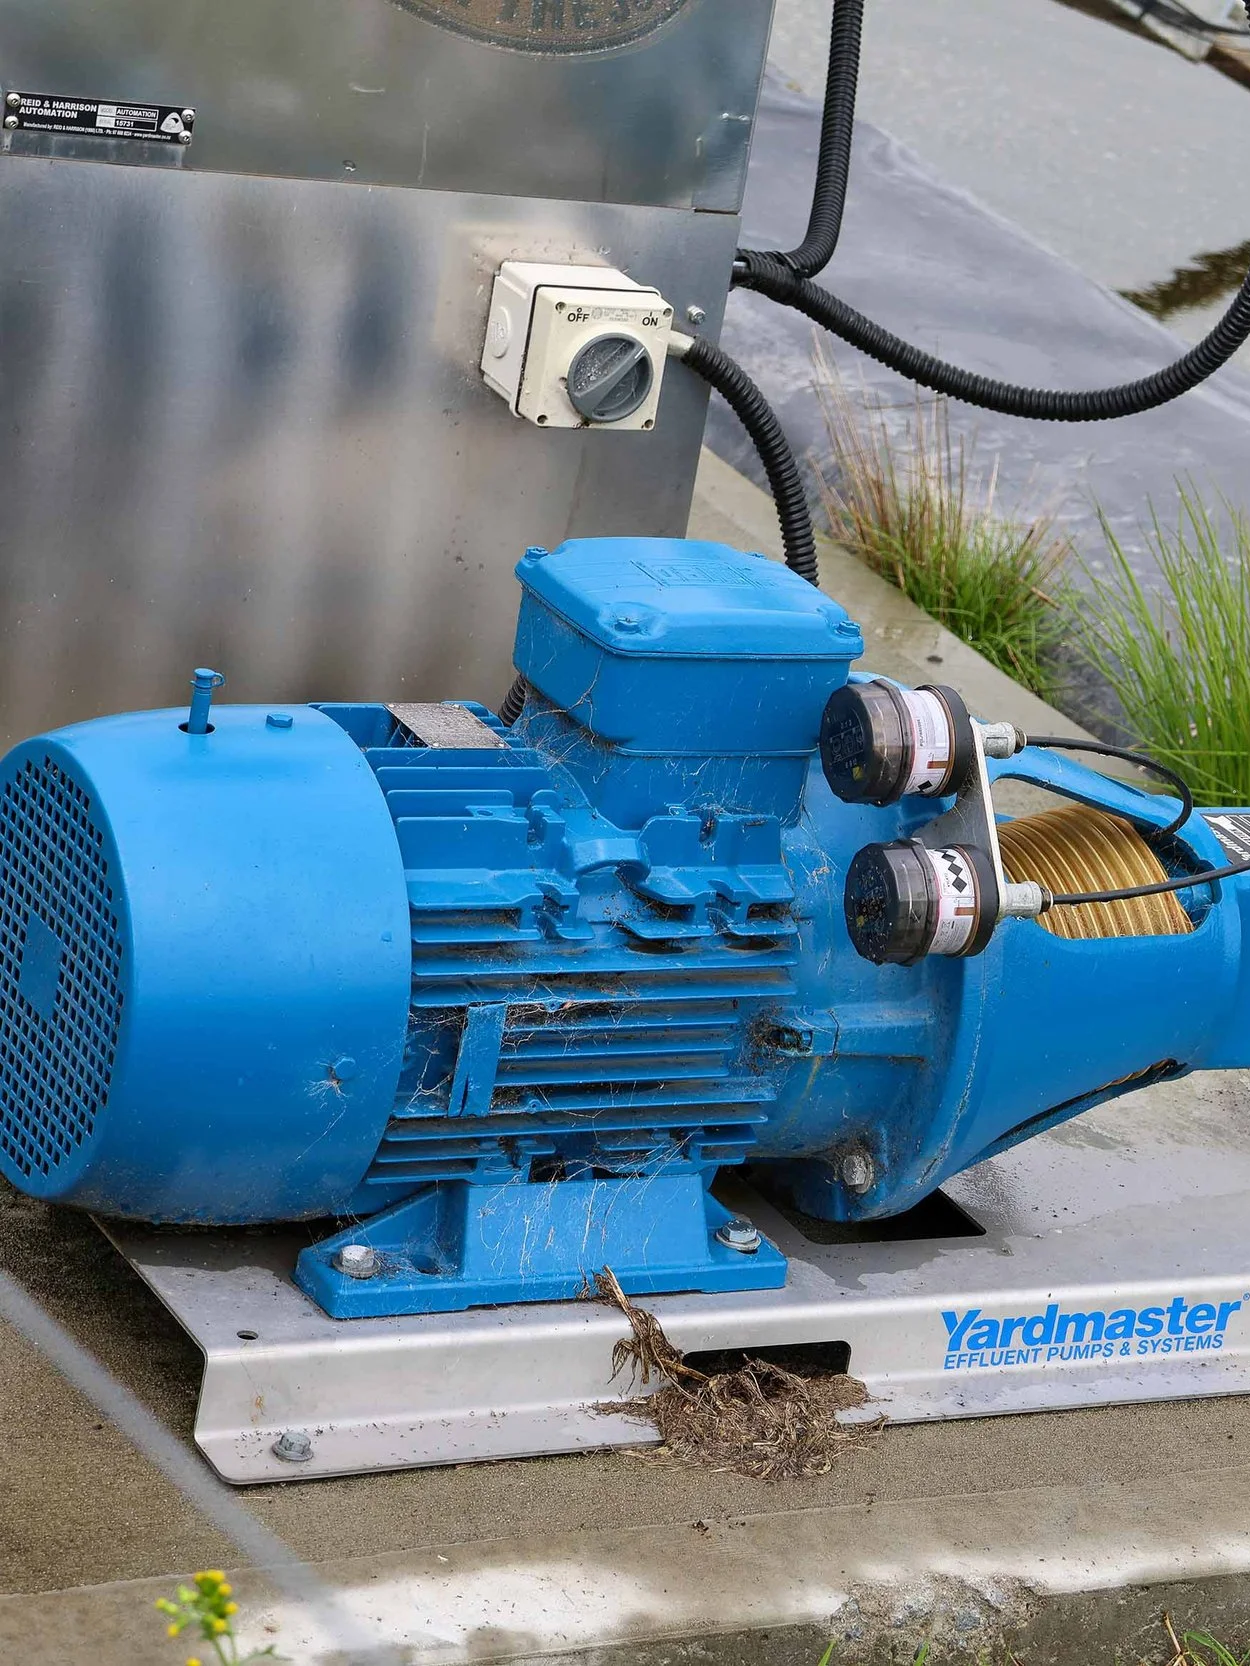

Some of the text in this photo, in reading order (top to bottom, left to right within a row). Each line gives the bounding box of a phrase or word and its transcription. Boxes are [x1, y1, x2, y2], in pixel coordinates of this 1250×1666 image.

[20, 98, 41, 107] REID
[43, 100, 50, 108] &
[52, 101, 97, 112] HARRISON
[19, 106, 78, 119] AUTOMATION
[116, 108, 157, 118] AUTOMATION
[567, 312, 590, 322] OFF
[641, 316, 659, 327] ON
[943, 1333, 1224, 1370] EFFLUENT PUMPS & SYSTEMS
